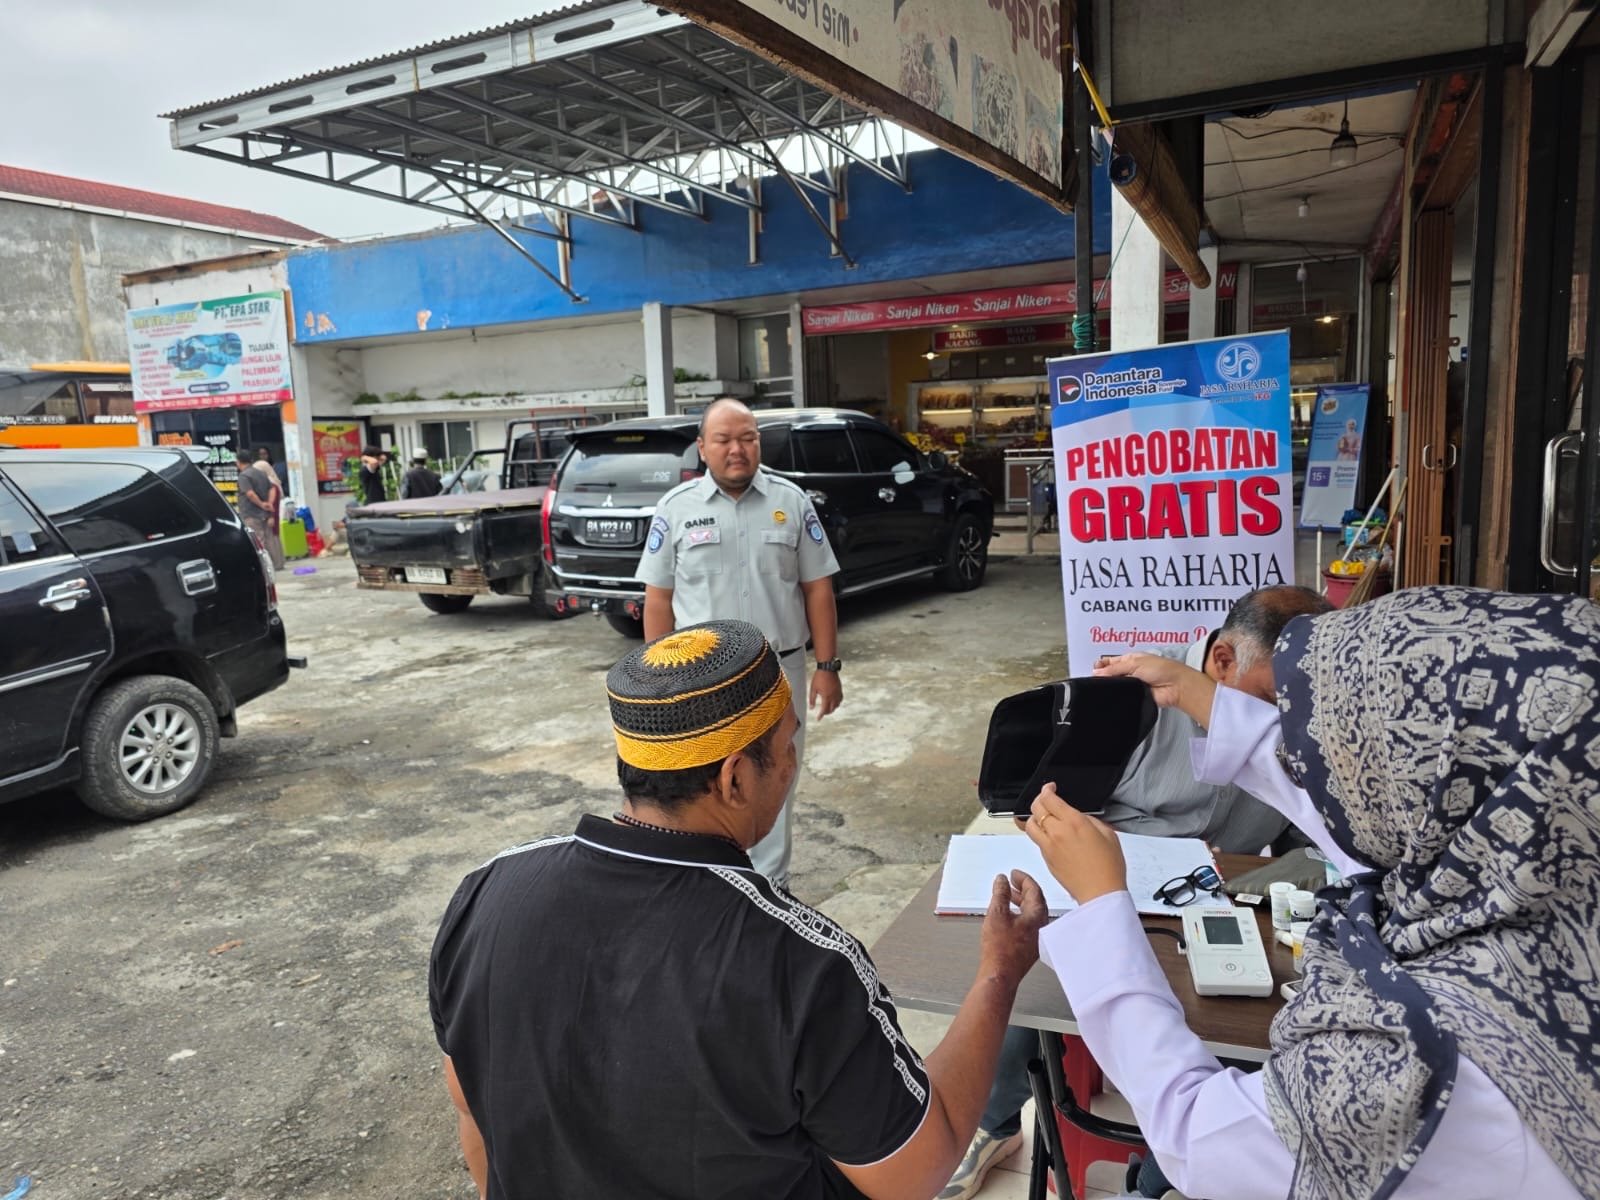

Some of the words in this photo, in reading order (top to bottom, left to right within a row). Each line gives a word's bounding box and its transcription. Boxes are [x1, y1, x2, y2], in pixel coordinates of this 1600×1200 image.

[230, 304, 246, 317] EPA
[248, 301, 271, 314] STAR
[807, 313, 839, 327] Sanjai
[843, 309, 874, 321] Niken
[886, 305, 922, 319] Sanjai
[925, 303, 959, 315] Niken
[973, 297, 1011, 313] Sanjai
[1015, 294, 1052, 308] Niken
[1085, 368, 1161, 386] Danantara
[1200, 383, 1226, 394] JASA
[1227, 378, 1280, 392] RAHARJA
[1085, 382, 1157, 400] Indonesia
[1066, 428, 1277, 481] PENGOBATAN
[1068, 475, 1282, 543] GRATIS
[685, 517, 716, 529] GANIS
[1070, 557, 1132, 595] JASA
[1140, 552, 1287, 590] RAHARJA
[1081, 599, 1151, 612] CABANG
[1158, 598, 1239, 612] BUKITTIN
[1089, 626, 1189, 647] Bekerjasama
[789, 907, 825, 933] DIOR
